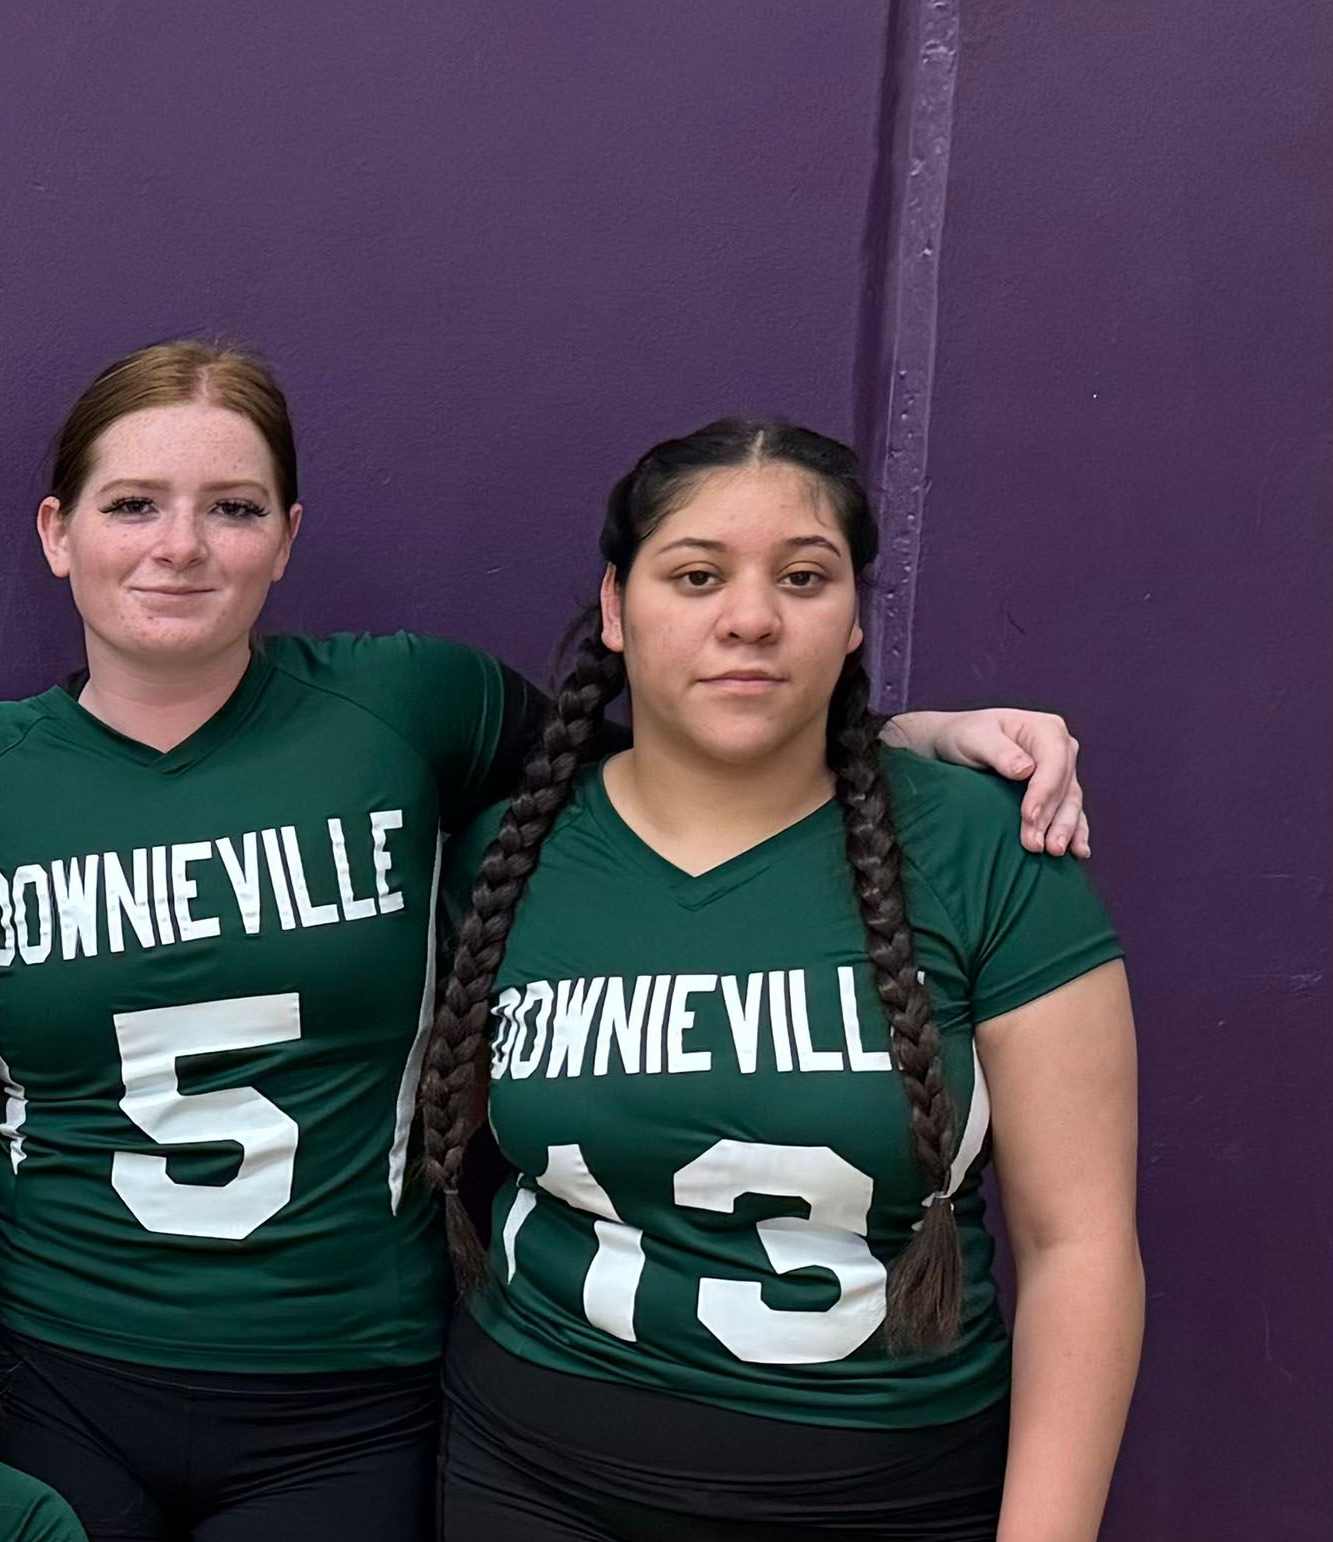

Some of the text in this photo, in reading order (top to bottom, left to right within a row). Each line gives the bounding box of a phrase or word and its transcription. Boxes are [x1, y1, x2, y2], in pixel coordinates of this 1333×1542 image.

[111, 992, 301, 1240] 5
[490, 965, 925, 1080] DOWNIEVILL
[535, 1138, 888, 1365] 13
